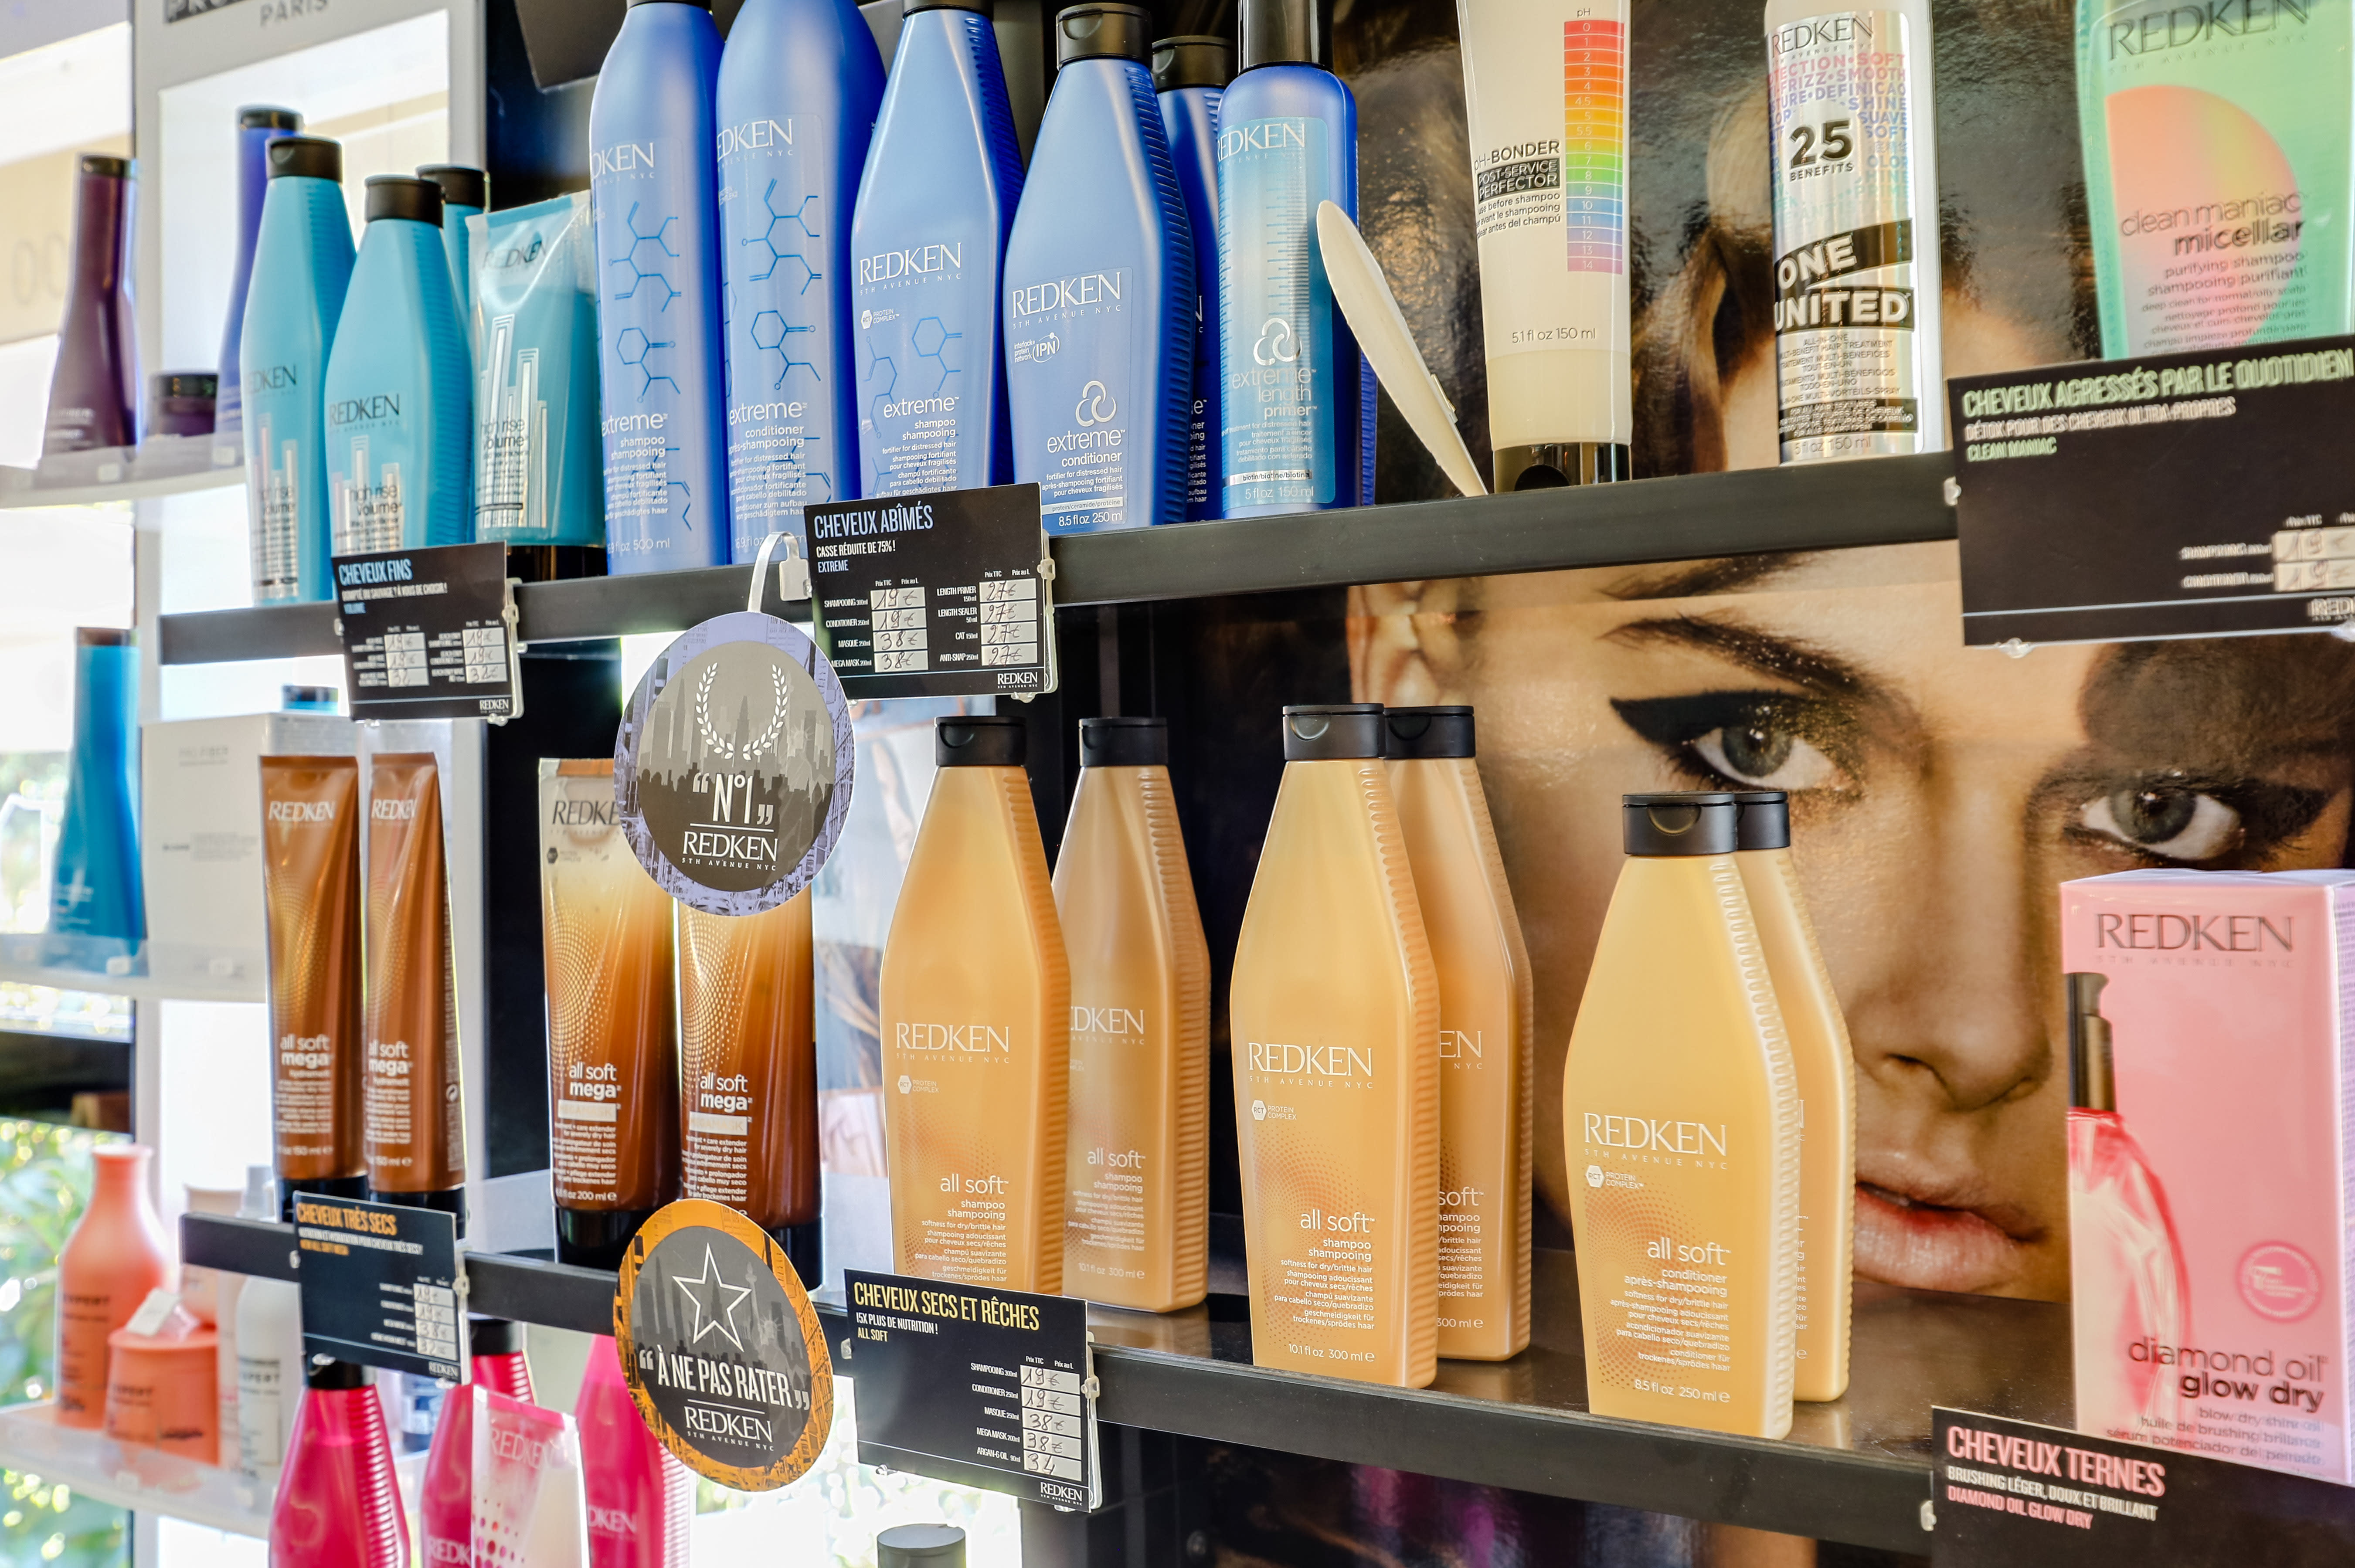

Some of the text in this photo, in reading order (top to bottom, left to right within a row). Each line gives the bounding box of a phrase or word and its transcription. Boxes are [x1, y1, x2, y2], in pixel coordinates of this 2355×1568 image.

[1577, 7, 1590, 18] pH
[1772, 15, 1873, 58] REDKEN
[2109, 0, 2310, 61] REDKEN
[1789, 119, 1853, 168] 25
[1475, 139, 1560, 171] pH-BONDER
[1479, 160, 1557, 186] POST-SERVICE
[1790, 161, 1853, 182] BENEFITS
[1479, 173, 1557, 200] PERFECTOR
[1488, 198, 1513, 210] before
[1516, 193, 1560, 205] shampoo
[1497, 211, 1503, 220] le
[1505, 204, 1560, 218] shampooing
[2122, 192, 2303, 237] clean maniac
[2175, 219, 2305, 256] micellar
[860, 243, 962, 285] REDKEN
[1779, 235, 1857, 288] ONE
[2165, 258, 2228, 278] purifying
[1013, 272, 1122, 319] REDKEN
[1013, 305, 1121, 329] 5TH AVENUE NYC
[1775, 290, 1910, 332] UNITED
[1512, 328, 1595, 343] 5.1 150 ml
[1036, 341, 1056, 356] IPN
[1963, 349, 2353, 418] CHEVEUX AGRESSÉS PAR LE QUOTIDIEN
[1259, 384, 1312, 405] length
[329, 394, 400, 427] REDKEN
[746, 425, 804, 437] conditioner
[903, 429, 955, 440] shampooing
[915, 419, 955, 429] shampoo
[621, 436, 665, 447] shampoo
[912, 442, 942, 450] distressed
[1968, 438, 2056, 462] CLEAN MANIAC
[612, 446, 665, 461] shampooing
[1062, 452, 1122, 467] conditioner
[1076, 468, 1108, 476] distressed
[1094, 483, 1123, 492] fragilisés
[814, 501, 934, 539] CHEVEUX ABÎMÉS
[1059, 510, 1123, 526] 8.5 250 ml
[816, 540, 876, 557] CASSE RÉDUITE DE
[338, 559, 412, 586] CHEVEUX FINS
[818, 560, 849, 573] EXTREME
[958, 586, 976, 594] PRIMER
[997, 672, 1037, 685] REDKEN
[480, 699, 509, 710] REDKEN
[268, 801, 335, 821] REDKEN
[683, 831, 778, 862] REDKEN
[708, 860, 749, 869] AVENUE
[2097, 913, 2294, 952] REDKEN
[896, 1023, 1009, 1053] REDKEN
[1248, 1042, 1373, 1077] REDKEN
[569, 1062, 617, 1081] all soft
[700, 1072, 748, 1093] all soft
[1280, 1078, 1333, 1087] AVENUE
[1584, 1113, 1726, 1156] REDKEN
[941, 1174, 959, 1192] all
[948, 1208, 1006, 1221] shampooing
[961, 1199, 1005, 1210] shampoo
[296, 1202, 397, 1235] CHEVEUX TRÈS SECS
[1301, 1209, 1321, 1230] all
[1323, 1238, 1371, 1250] shampoo
[1648, 1237, 1671, 1259] all
[1308, 1248, 1372, 1262] shampooing
[1281, 1259, 1306, 1268] softness
[1320, 1264, 1356, 1273] dry/brittle
[1662, 1269, 1727, 1283] conditioner
[1624, 1275, 1727, 1297] après-shampooing
[854, 1282, 1040, 1331] CHEVEUX SECS ET RÊCHES
[868, 1315, 886, 1327] PLUS
[887, 1318, 896, 1329] DE
[897, 1319, 934, 1334] NUTRITION
[858, 1329, 888, 1342] ALL SOFT
[1288, 1344, 1363, 1361] 10.1 300 ml
[2129, 1337, 2274, 1377] diamond
[671, 1354, 696, 1391] NE
[697, 1357, 732, 1397] PAS
[2180, 1371, 2324, 1413] glow dry
[984, 1407, 1006, 1418] MASQUE
[684, 1406, 772, 1443] REDKEN
[1947, 1426, 2165, 1497] CHEVEUX TERNES
[1040, 1482, 1082, 1502] REDKEN
[1948, 1466, 2006, 1491] BRUSHING
[2049, 1485, 2081, 1507] DOUX
[2084, 1493, 2097, 1509] ET
[2100, 1496, 2158, 1521] BRILLANT
[1948, 1486, 2093, 1530] DIAMOND OIL GLOW DRY
